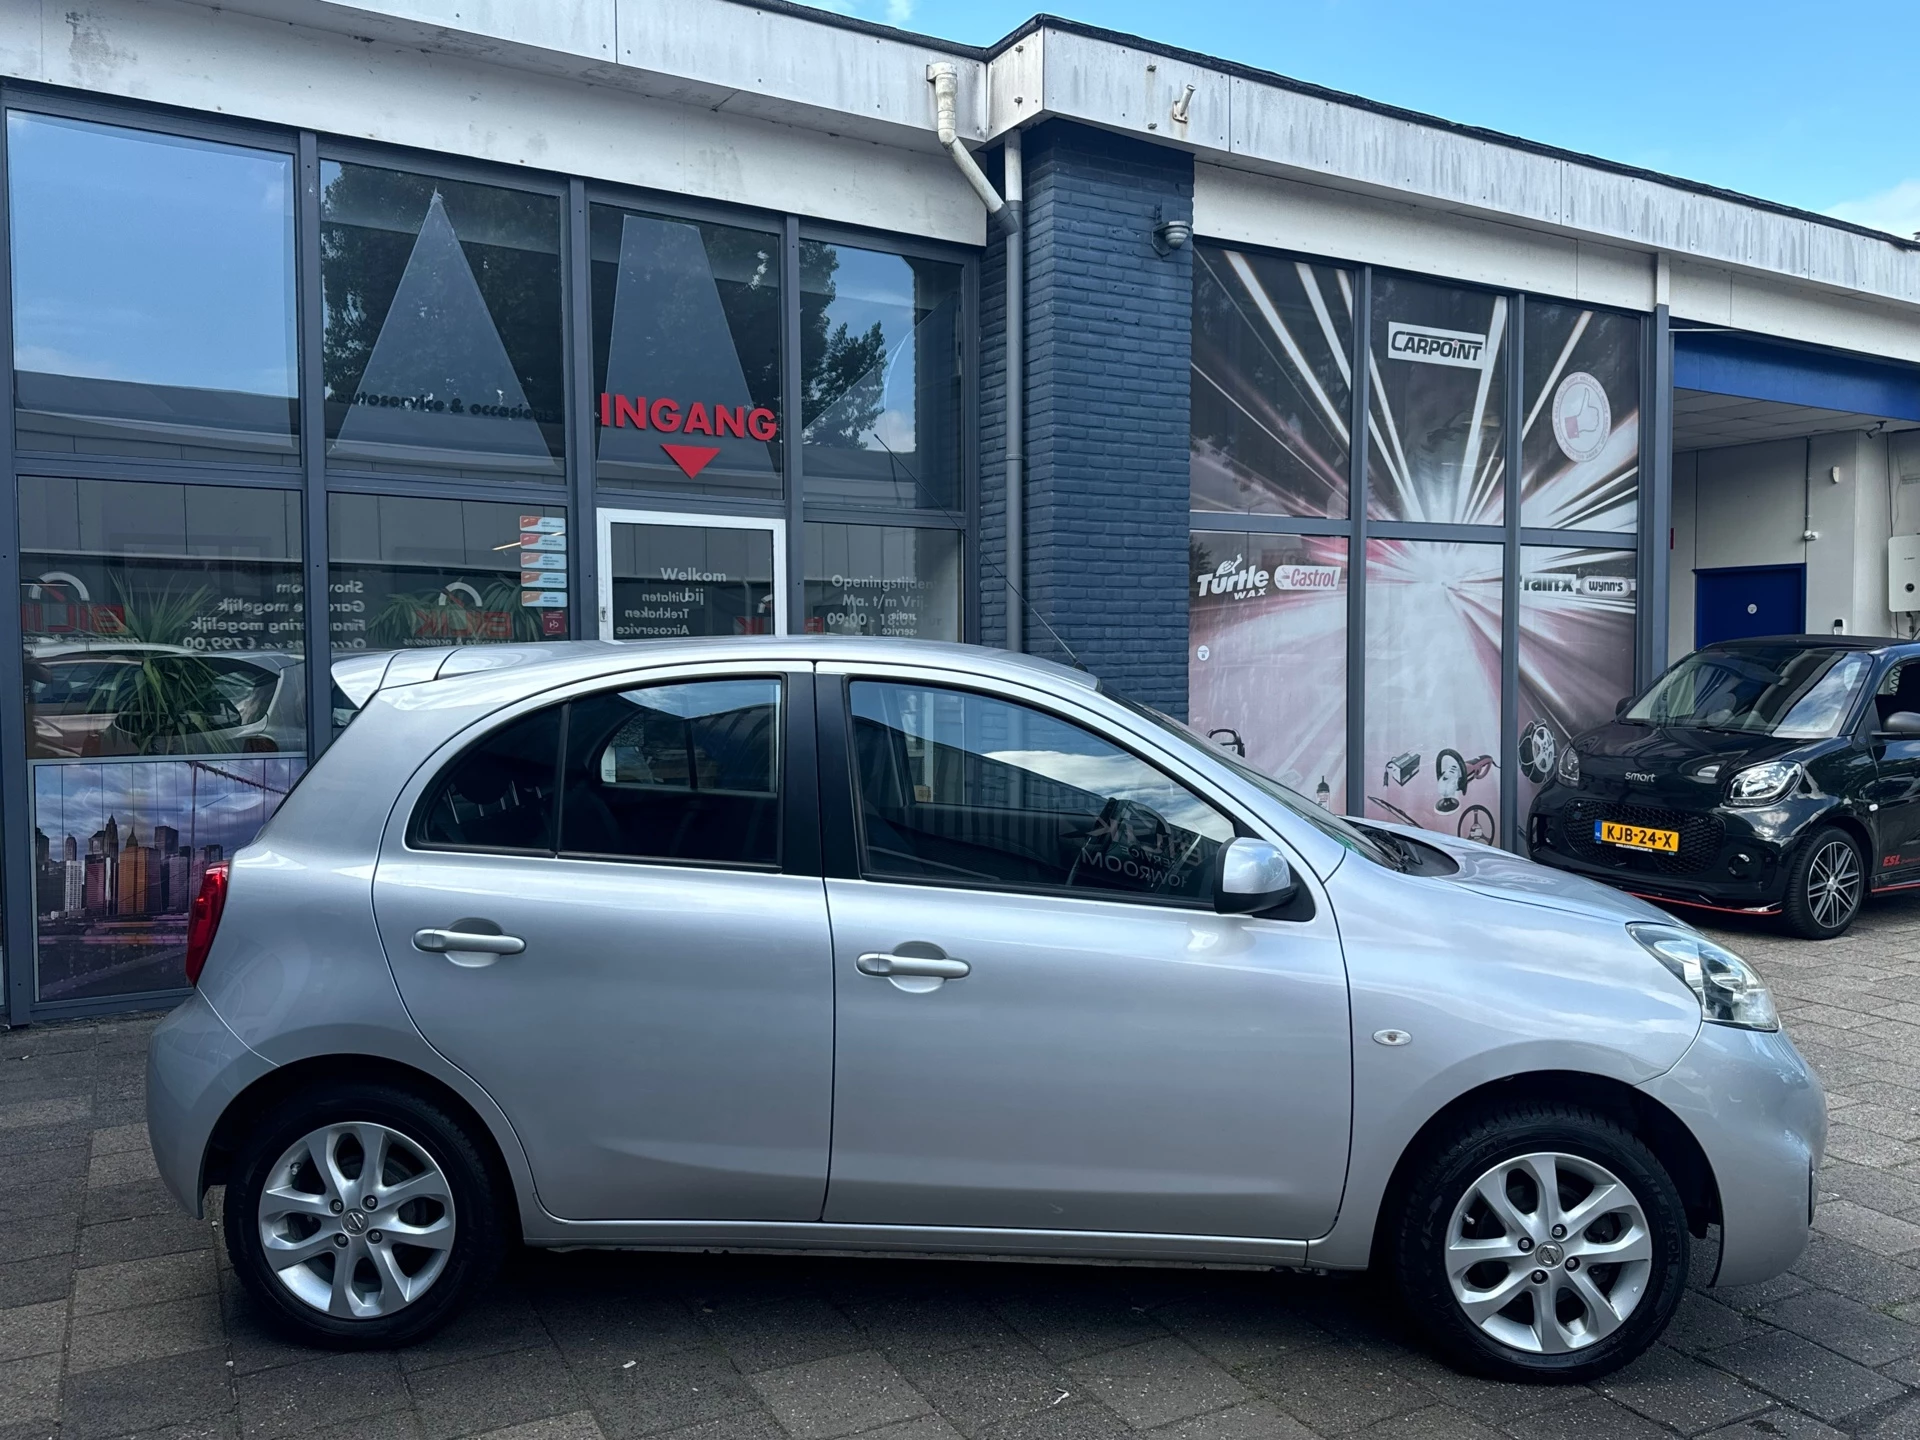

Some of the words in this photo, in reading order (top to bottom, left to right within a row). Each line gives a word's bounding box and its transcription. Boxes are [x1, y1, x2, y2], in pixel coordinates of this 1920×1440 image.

[450, 398, 464, 414] &
[470, 403, 555, 421] occasions
[601, 393, 777, 441] INGANG
[661, 568, 727, 582] Welkom
[1197, 565, 1269, 597] Turtle
[1291, 568, 1336, 587] Castrol
[842, 594, 869, 607] Ma.
[873, 594, 897, 609] t/m
[1234, 588, 1266, 600] WAX
[827, 612, 867, 626] 09:00
[1625, 772, 1656, 782] smart
[1607, 825, 1673, 848] KJB-24-X
